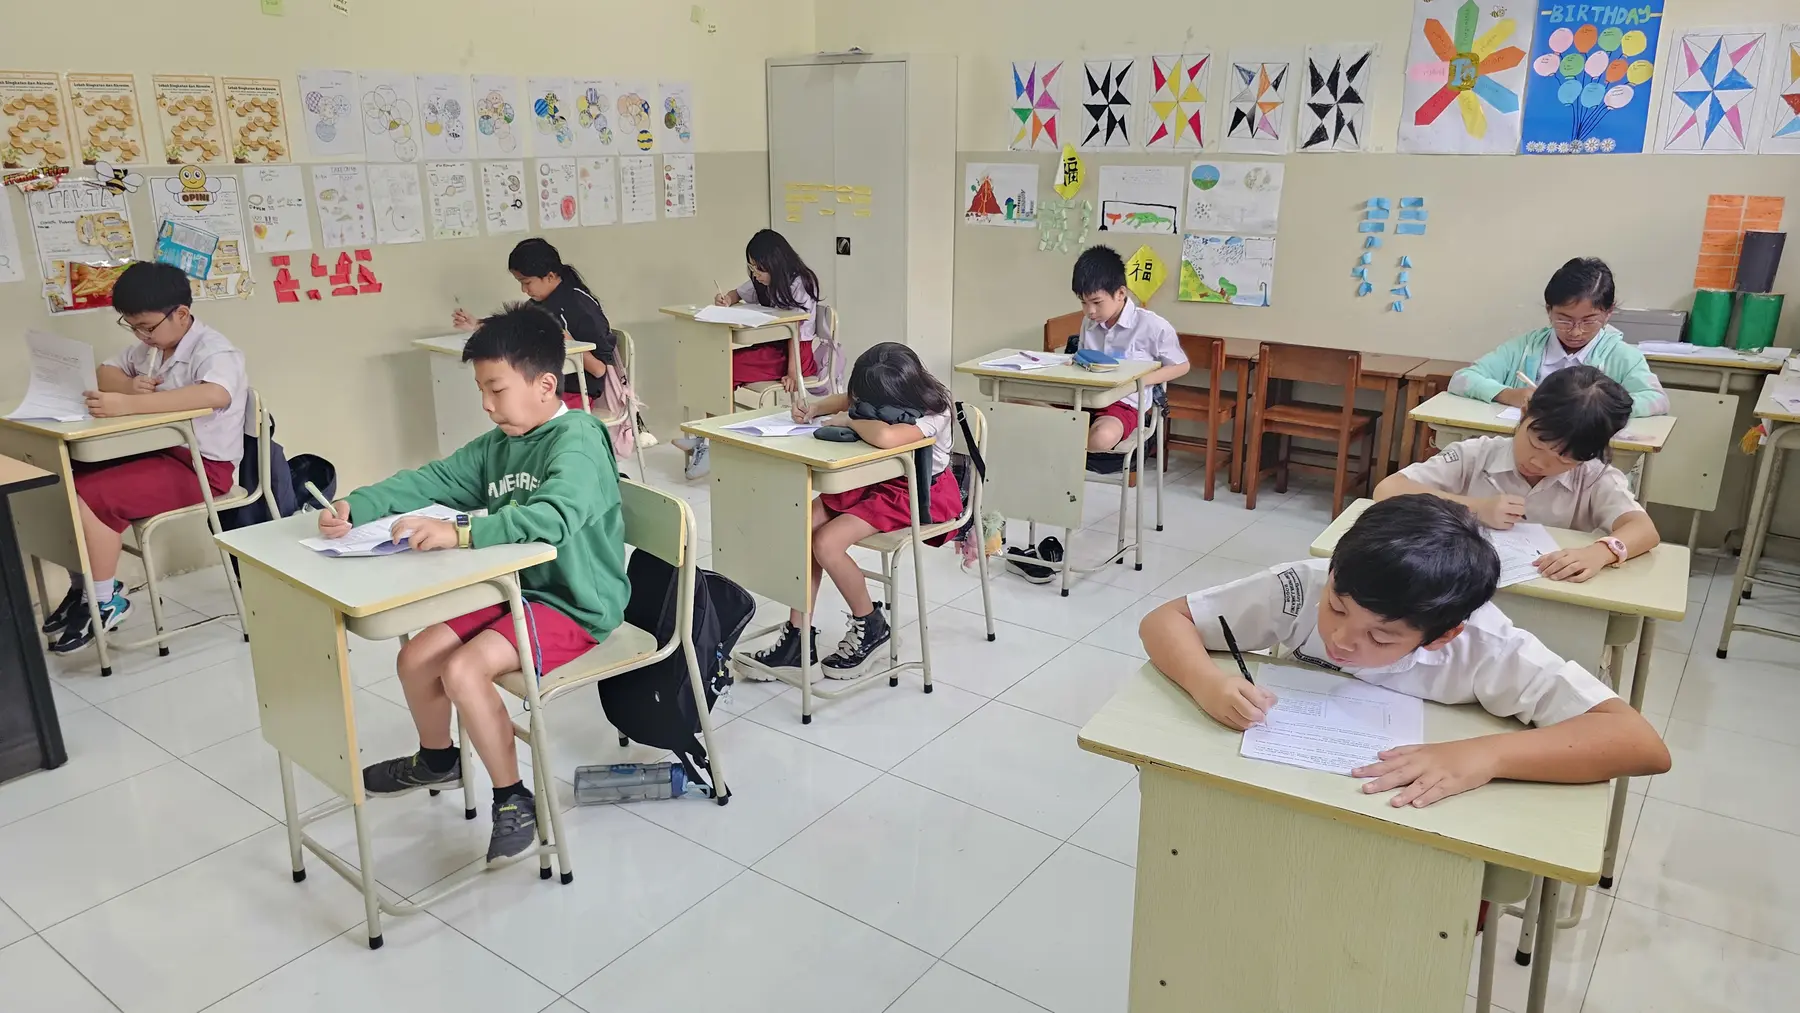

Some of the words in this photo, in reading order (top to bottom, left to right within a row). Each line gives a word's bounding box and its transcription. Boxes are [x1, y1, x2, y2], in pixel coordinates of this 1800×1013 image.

[1549, 4, 1651, 25] BIRTHDAY
[41, 166, 70, 176] Fries
[48, 188, 115, 208] FAKTA
[182, 193, 210, 202] OPINI
[1128, 259, 1153, 282] 福
